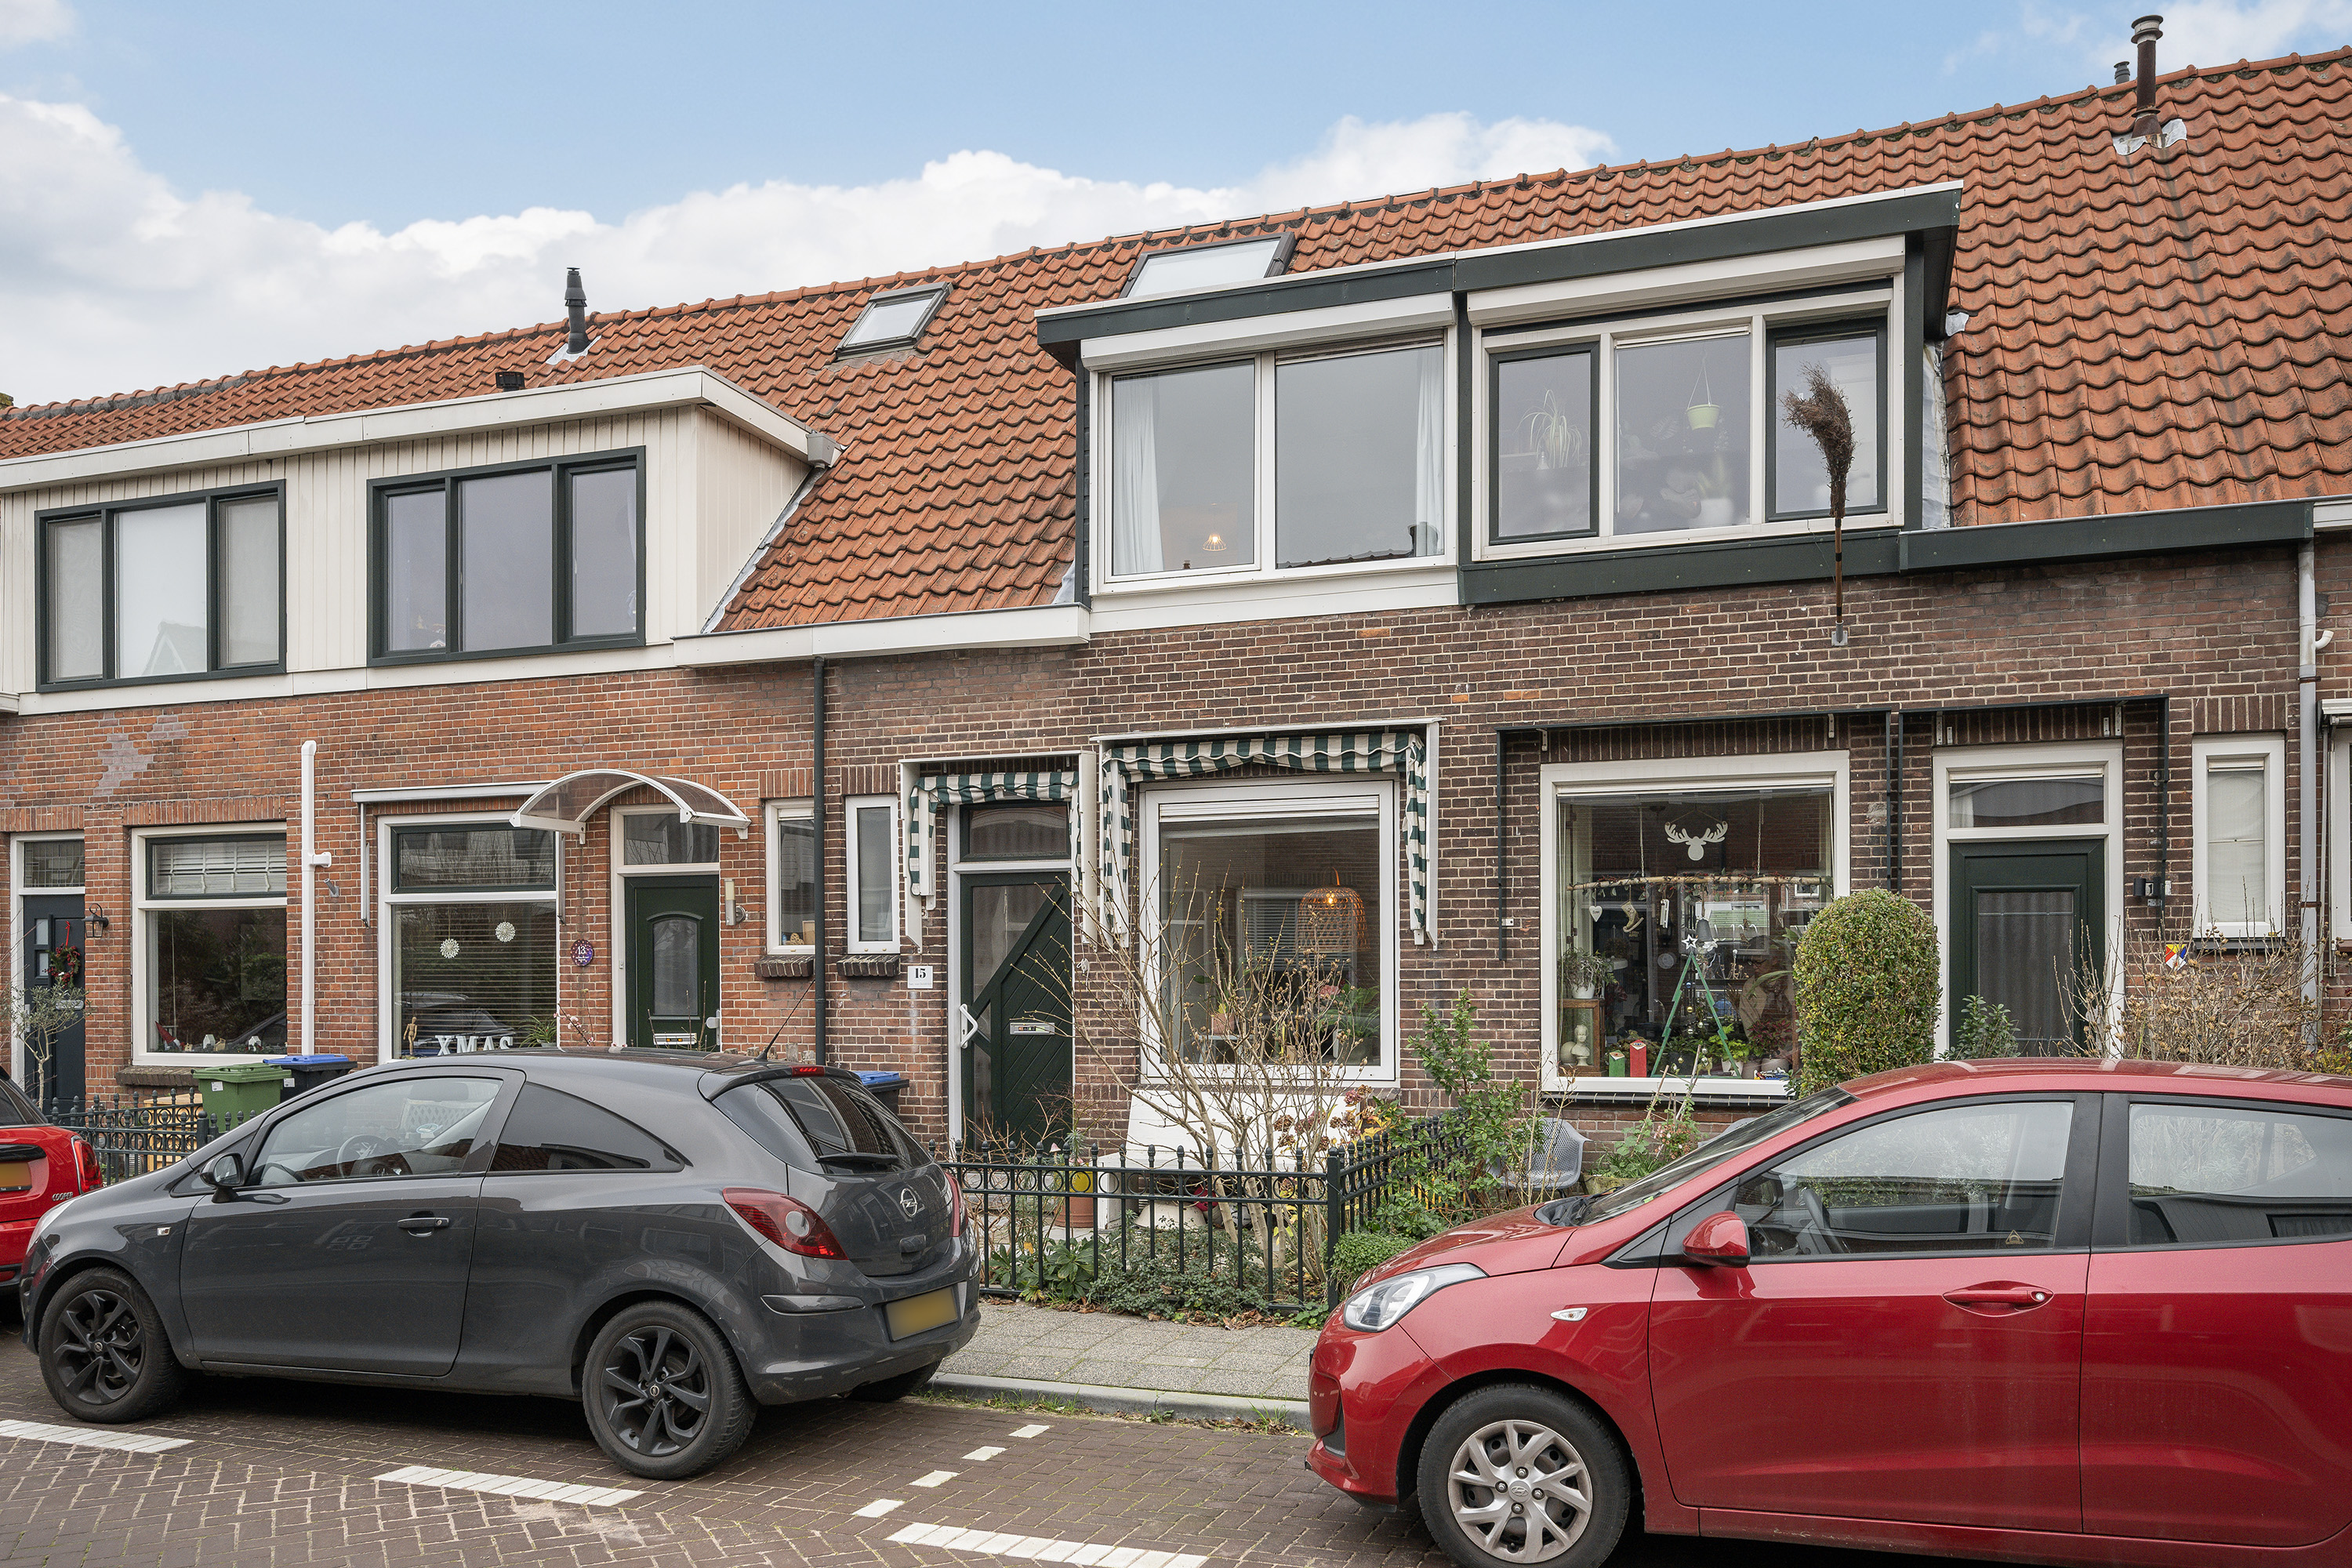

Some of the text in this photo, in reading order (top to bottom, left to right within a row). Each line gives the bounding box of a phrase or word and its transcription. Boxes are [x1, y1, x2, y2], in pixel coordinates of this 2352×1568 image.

[578, 946, 586, 955] 13
[915, 967, 927, 978] 15
[435, 1035, 513, 1056] XMAS
[52, 1192, 74, 1201] COOPER
